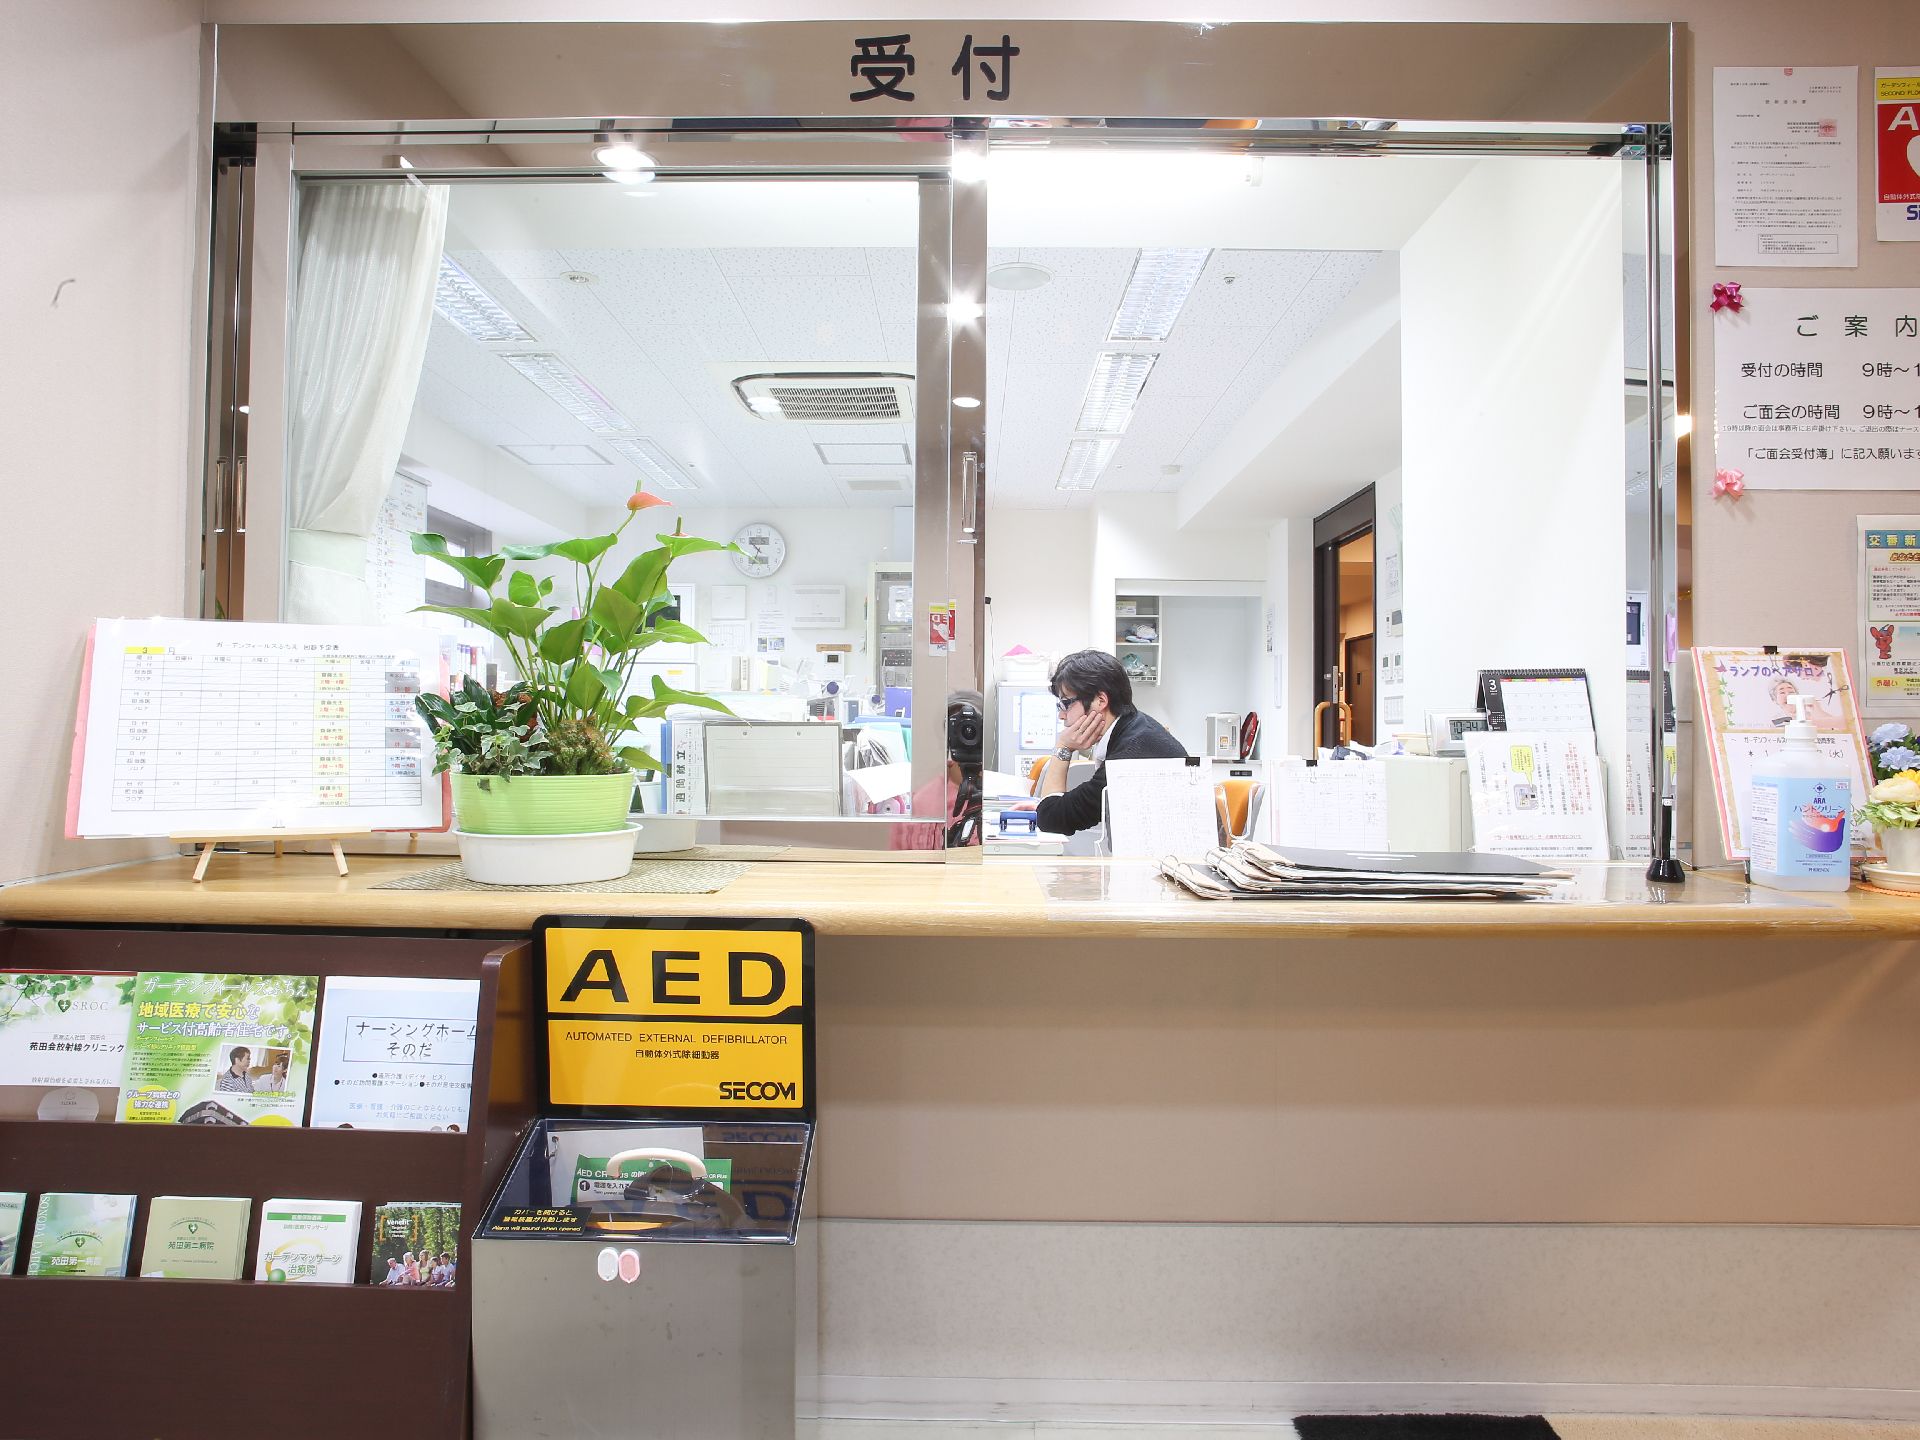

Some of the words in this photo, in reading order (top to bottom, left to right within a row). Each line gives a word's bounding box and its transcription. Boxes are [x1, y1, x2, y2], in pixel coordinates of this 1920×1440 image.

[850, 34, 1020, 102] 受付
[1906, 204, 1920, 221] S
[1796, 314, 1918, 338] ご案内
[1741, 362, 1824, 378] 受付の時間
[1743, 404, 1840, 420] ご面会の時間
[1488, 679, 1497, 691] 3
[1793, 804, 1846, 814] ハンドクリーン
[560, 949, 786, 1006] AED
[72, 1001, 109, 1011] SROC
[138, 1001, 260, 1020] 地域医療で安心な
[136, 1021, 294, 1039] サービス付高齢者住宅です。
[565, 1031, 633, 1043] AUTOMATED
[639, 1033, 696, 1044] EXTERNAL
[702, 1034, 788, 1045] DEFIBRILLATOR
[29, 1042, 125, 1053] 苑田会放射線クリニック
[387, 1042, 433, 1058] そのだ
[635, 1049, 720, 1060] 自動体外式除細動器
[719, 1081, 796, 1101] SECOM
[577, 1168, 592, 1178] AED
[34, 1195, 50, 1240] SONODA
[168, 1241, 215, 1250] 苑田第二病院
[288, 1264, 318, 1276] 治療院
